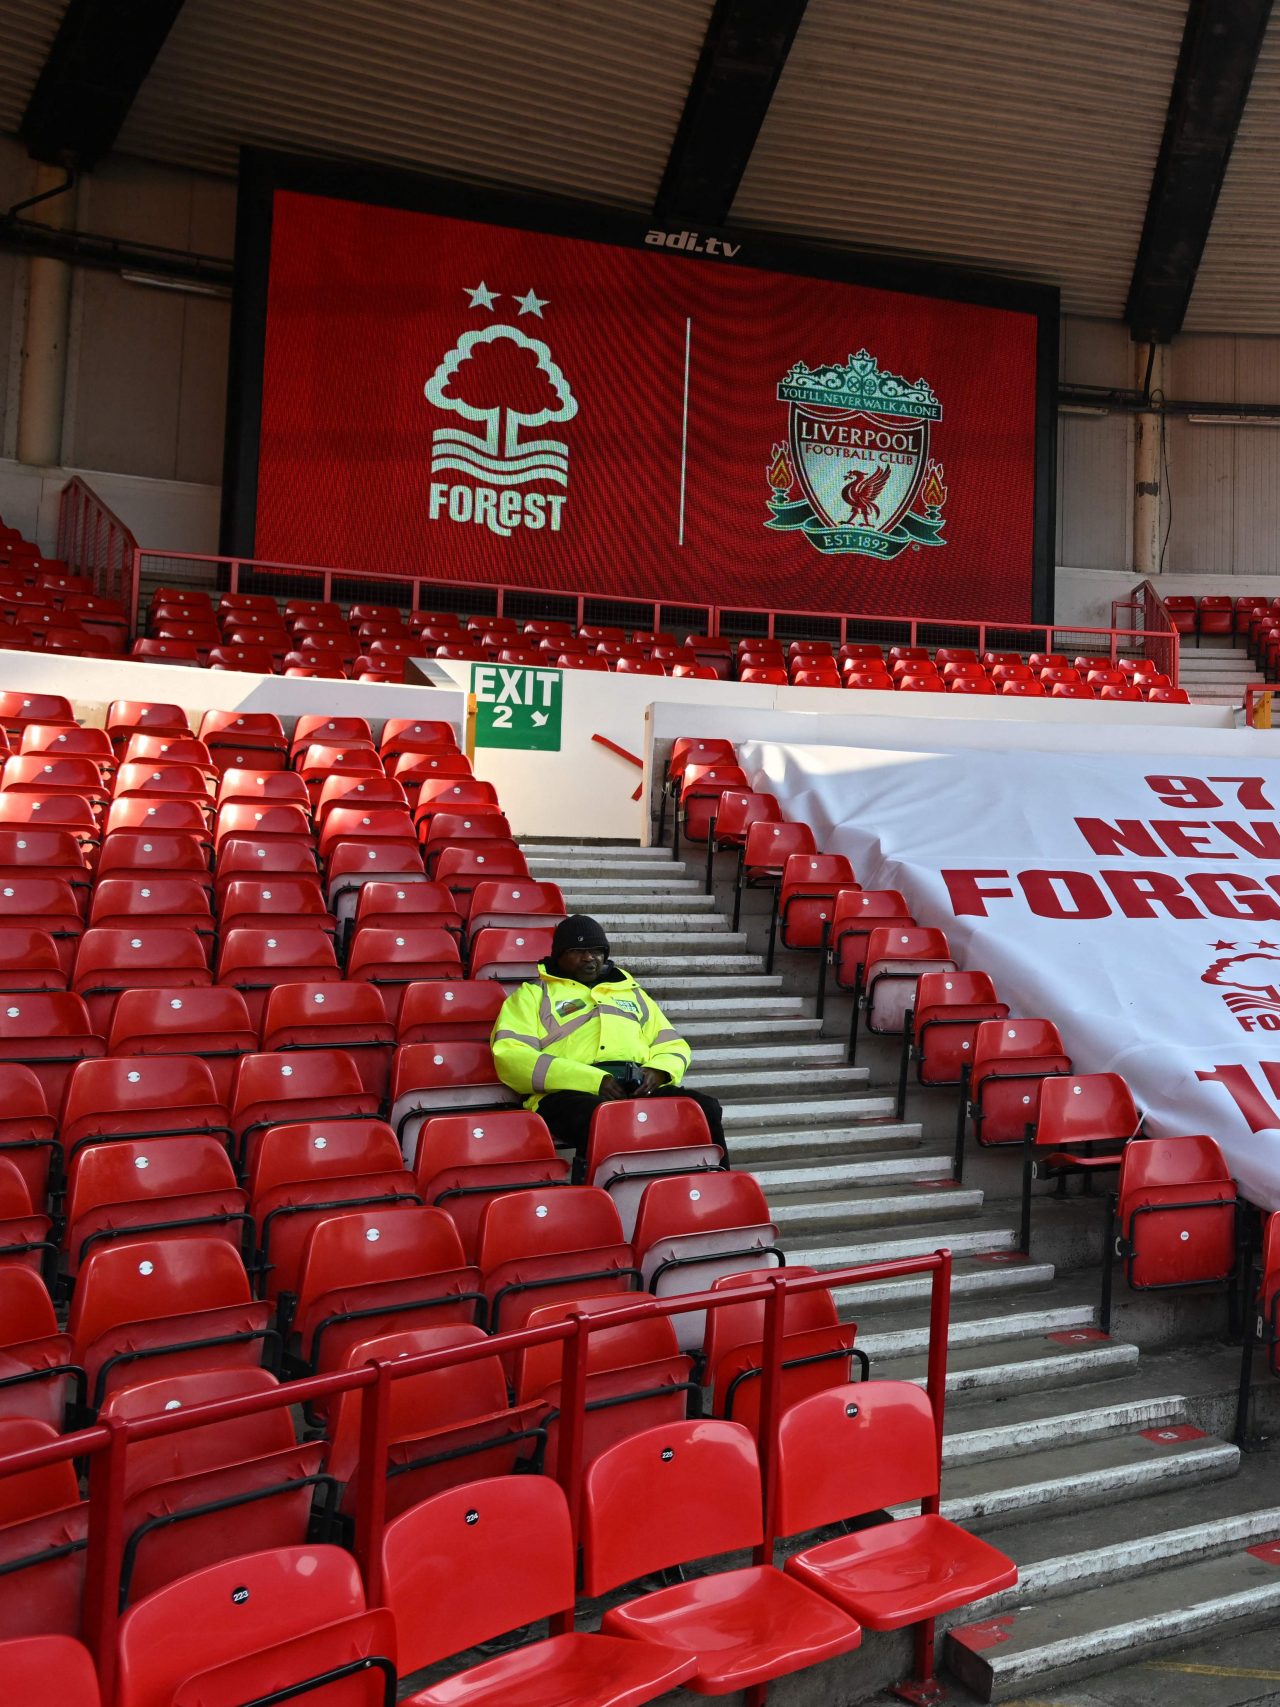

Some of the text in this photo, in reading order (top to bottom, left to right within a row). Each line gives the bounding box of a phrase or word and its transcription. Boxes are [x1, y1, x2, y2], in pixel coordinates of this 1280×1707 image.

[645, 230, 741, 257] adi.tv
[781, 387, 938, 417] YOU'LL NEVER WALK ALONE
[801, 422, 918, 452] LIVERPOOL
[806, 443, 913, 466] FOOTBALL CLUB
[475, 666, 560, 706] EXIT
[492, 705, 513, 728] 2
[1143, 775, 1275, 810] 97
[1256, 1315, 1263, 1339] B
[233, 1590, 249, 1602] 223
